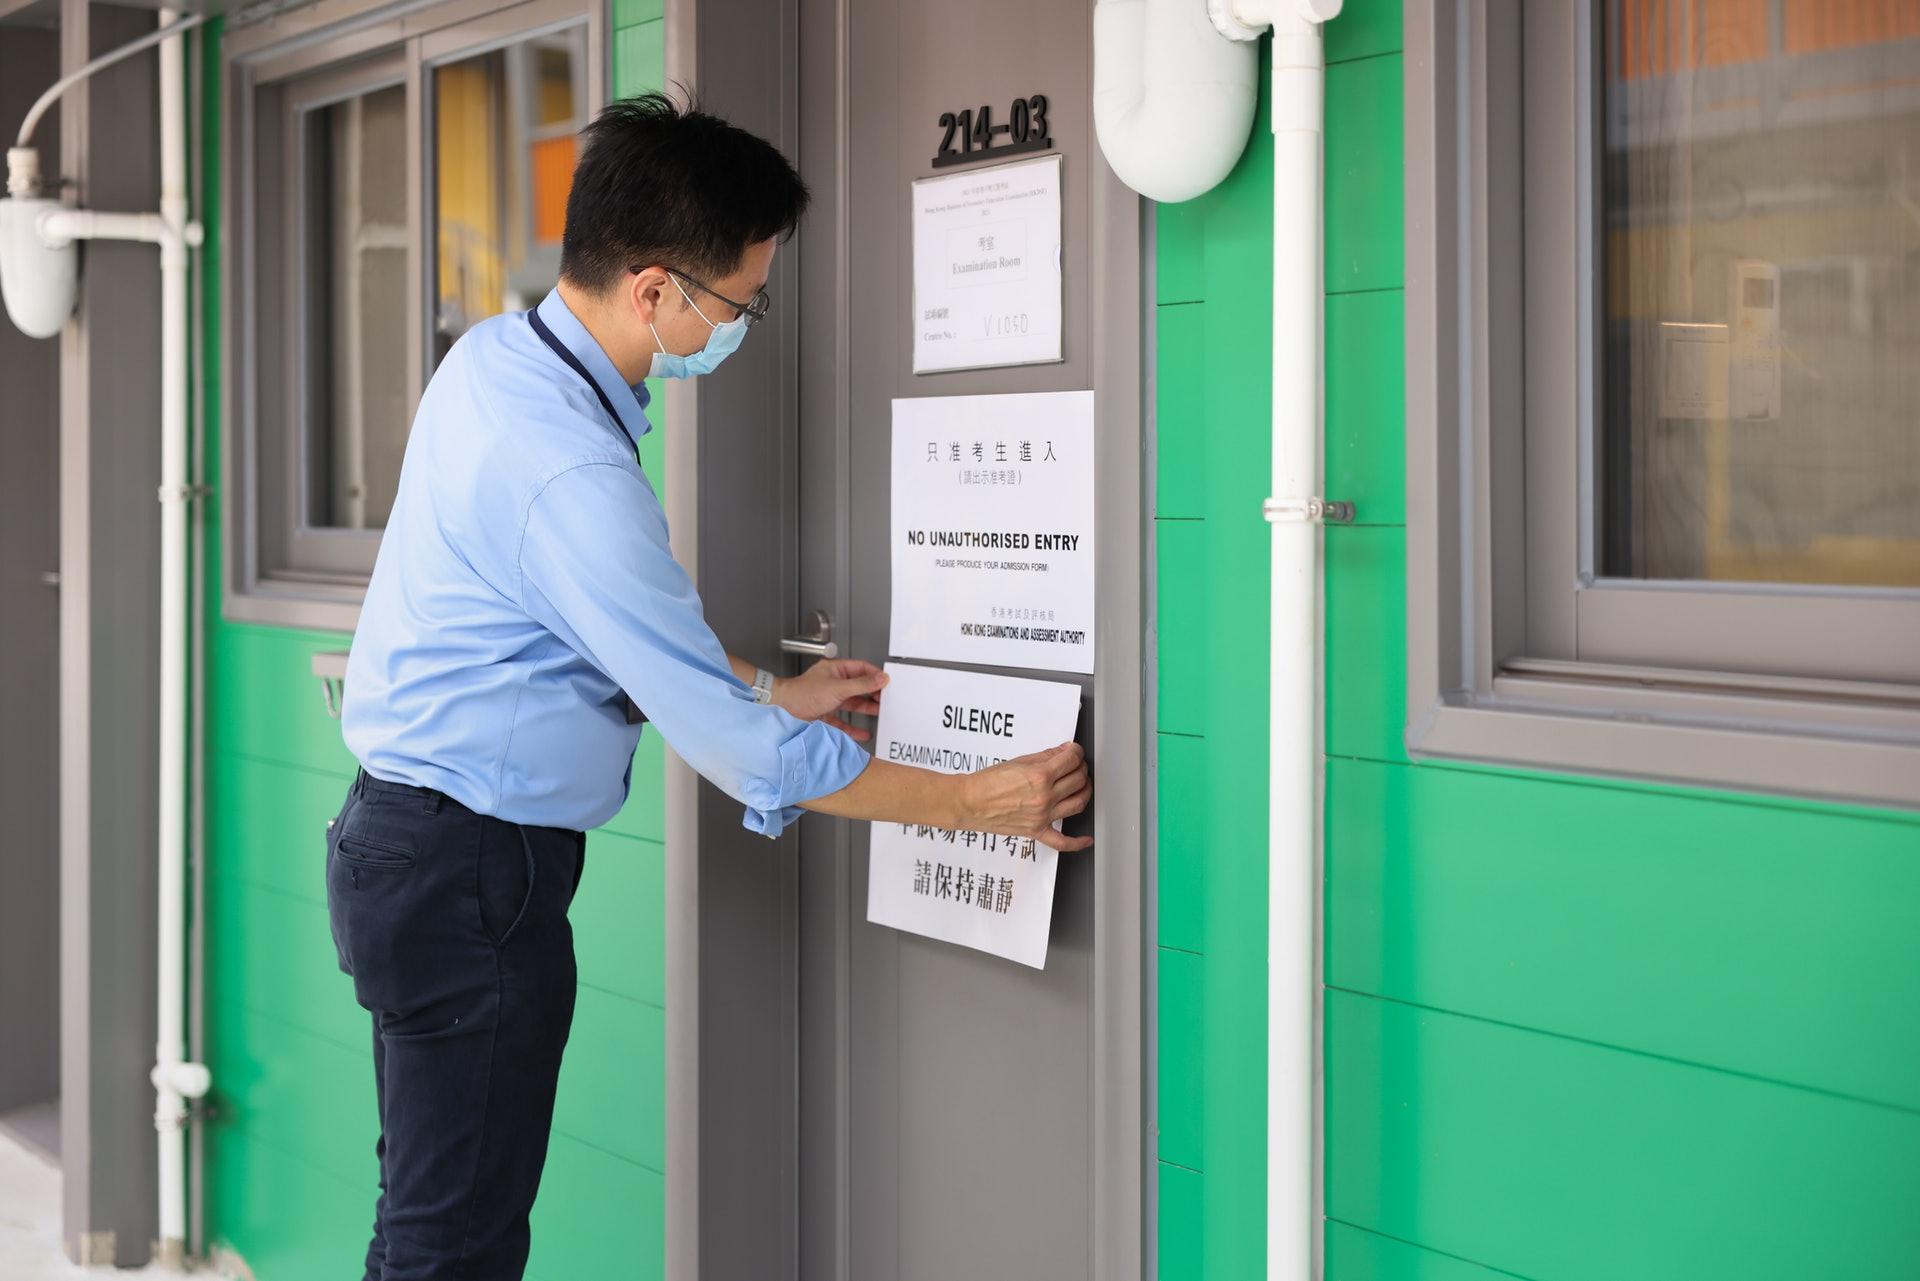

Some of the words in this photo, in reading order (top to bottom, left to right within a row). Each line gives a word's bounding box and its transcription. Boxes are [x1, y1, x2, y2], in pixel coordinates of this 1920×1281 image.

[938, 94, 1048, 155] 214-03
[952, 259, 998, 275] Examination
[999, 256, 1021, 268] Room
[927, 440, 1057, 463] 只准考生進入
[908, 530, 925, 545] NO
[930, 531, 1030, 549] UNAUTHORISED
[1035, 534, 1079, 551] ENTRY
[956, 559, 982, 569] PRODUCE
[983, 561, 999, 570] YOUR
[1000, 561, 1030, 571] ADMISSION
[960, 622, 973, 636] HONG
[974, 623, 986, 637] KONG
[986, 624, 1019, 640] EXAMINATIONS
[1020, 627, 1030, 641] AND
[1030, 628, 1059, 643] ASSESSMENT
[1060, 630, 1086, 645] AUTHORITY
[942, 704, 1015, 738] SILENCE
[889, 741, 972, 772] EXAMINATION
[975, 754, 988, 773] IN
[913, 858, 1015, 914] 請保持肅靜
